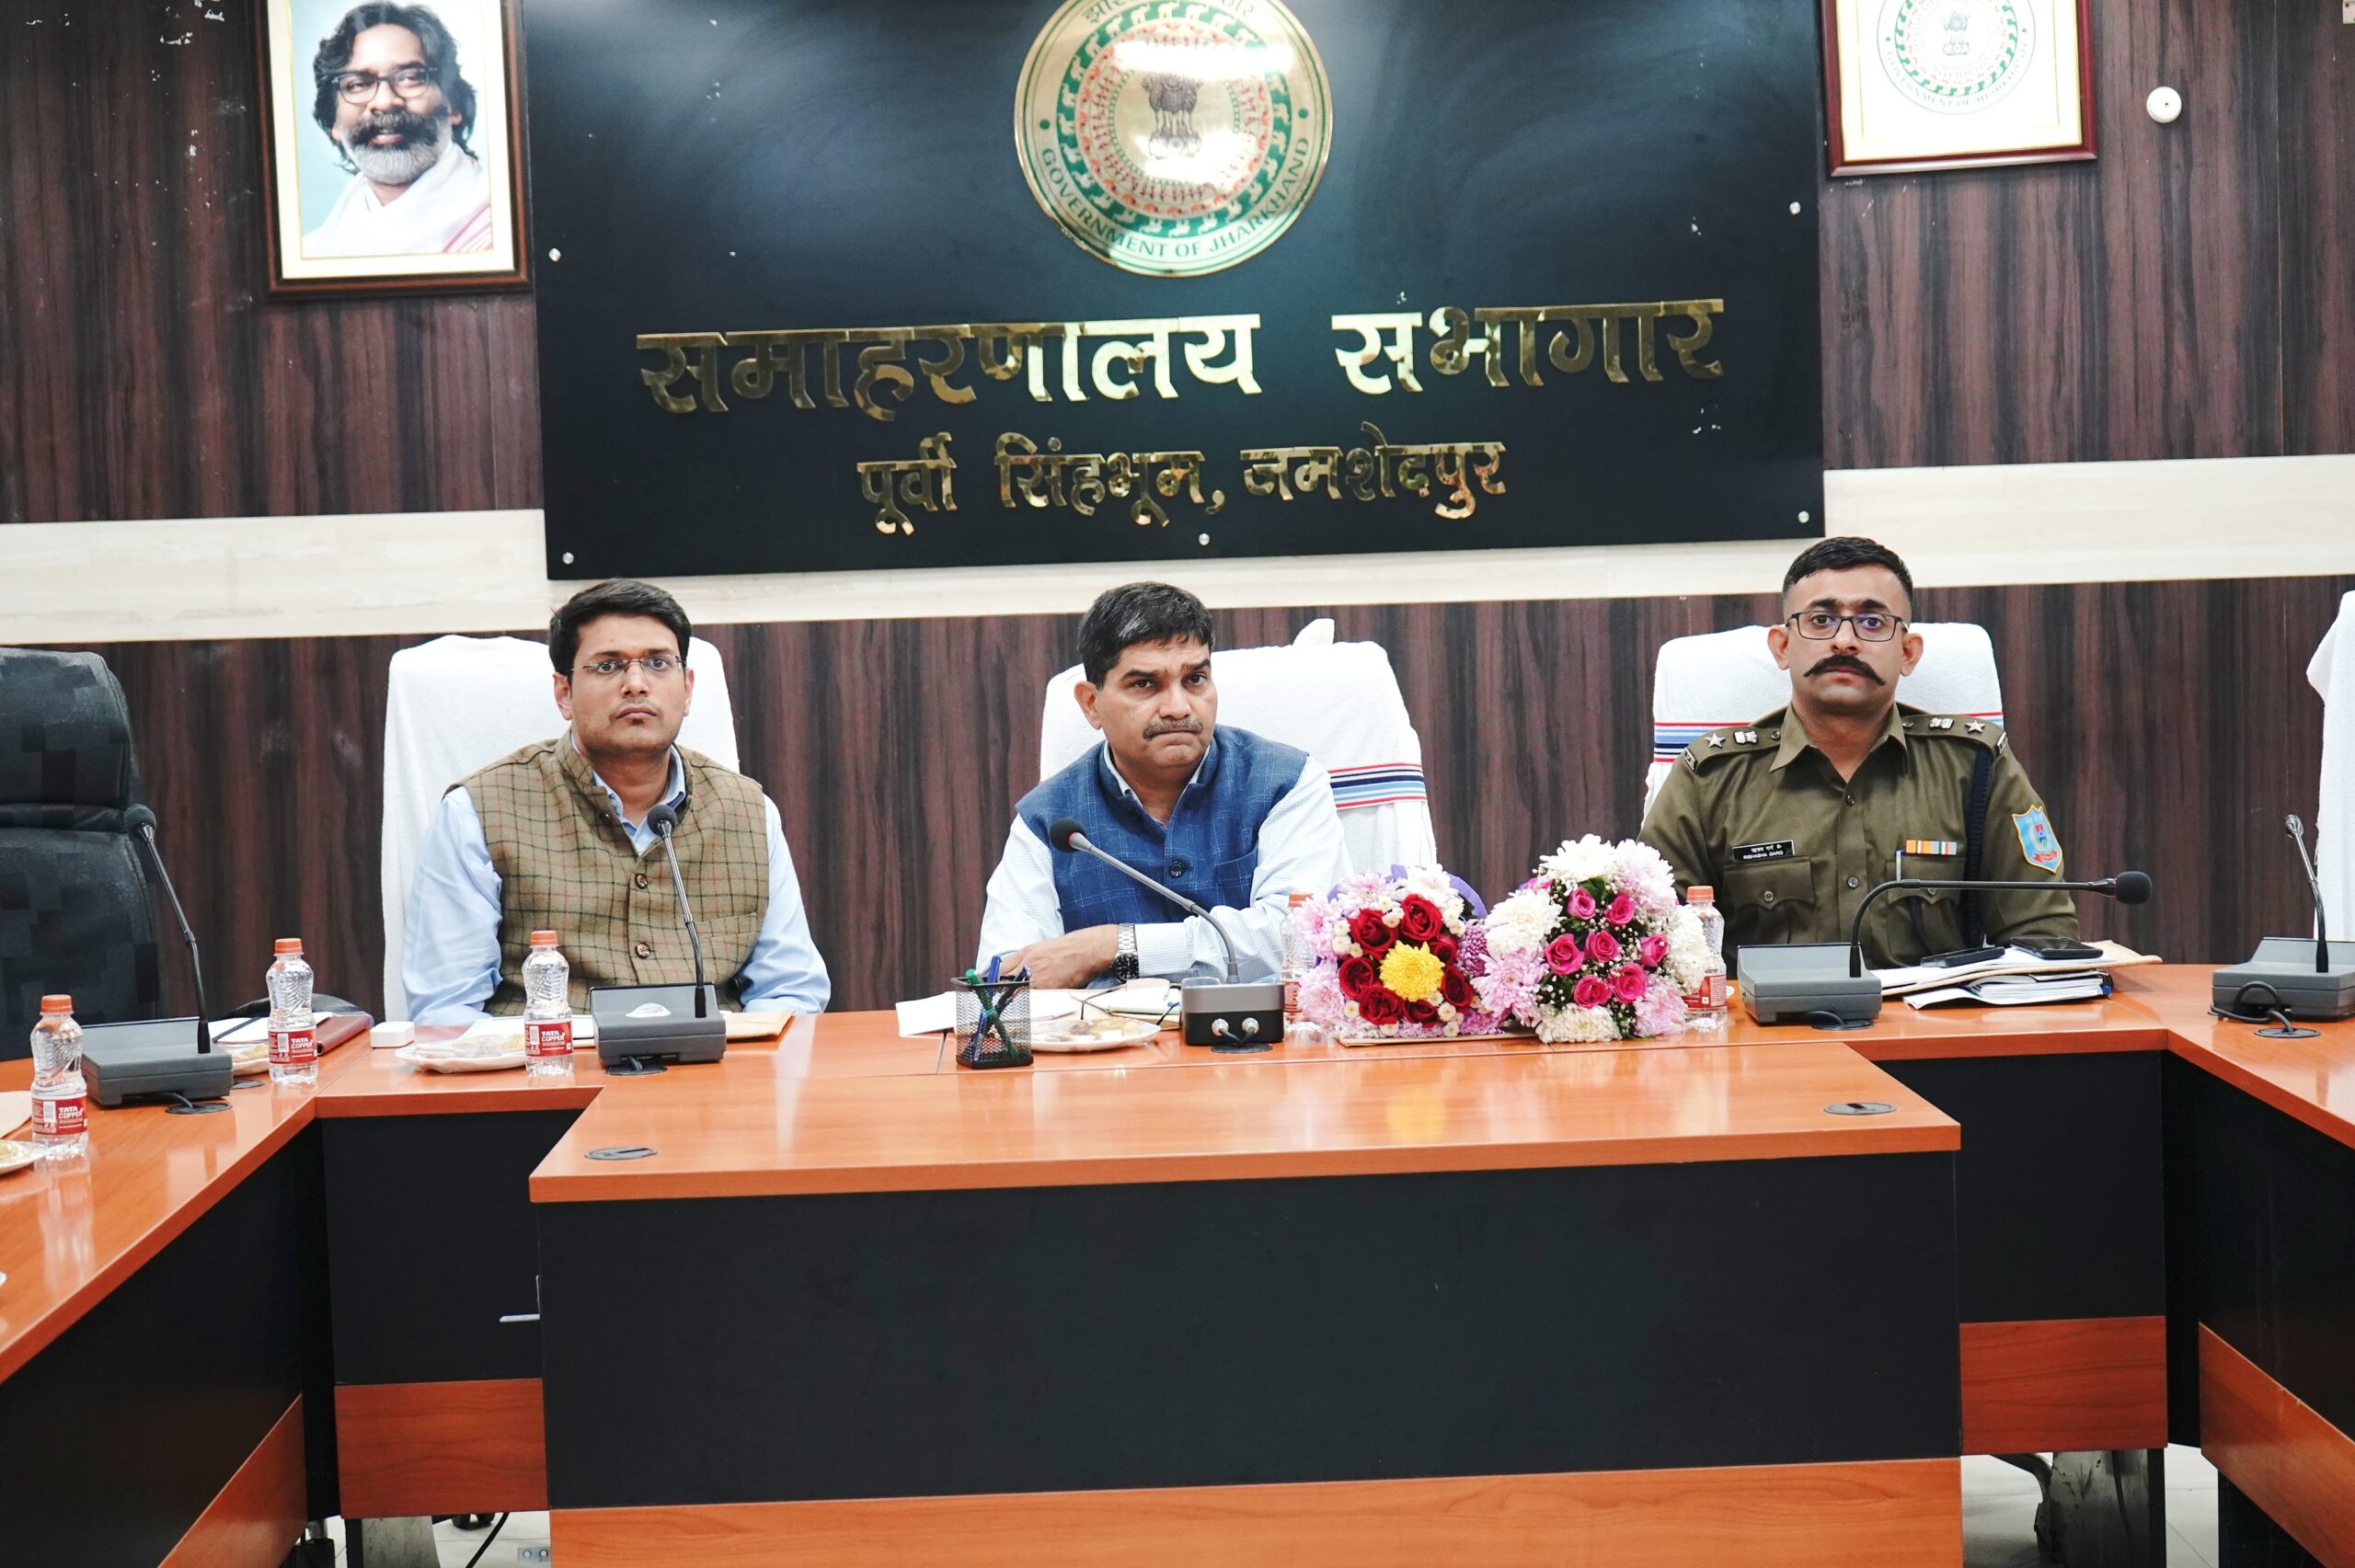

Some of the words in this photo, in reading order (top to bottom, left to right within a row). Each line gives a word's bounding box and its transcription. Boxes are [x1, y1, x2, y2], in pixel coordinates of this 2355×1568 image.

[1040, 147, 1168, 258] GOVERNMENT
[1175, 242, 1202, 258] OF
[1209, 137, 1310, 253] JHARKHAND
[636, 313, 1263, 421] समाहरणालय
[1330, 298, 1725, 395] सभागार
[856, 430, 959, 536] पूर्वी
[994, 431, 1225, 528] सिंहभूम,
[1239, 420, 1507, 520] जमशेदपुर
[58, 1105, 78, 1114] TATA
